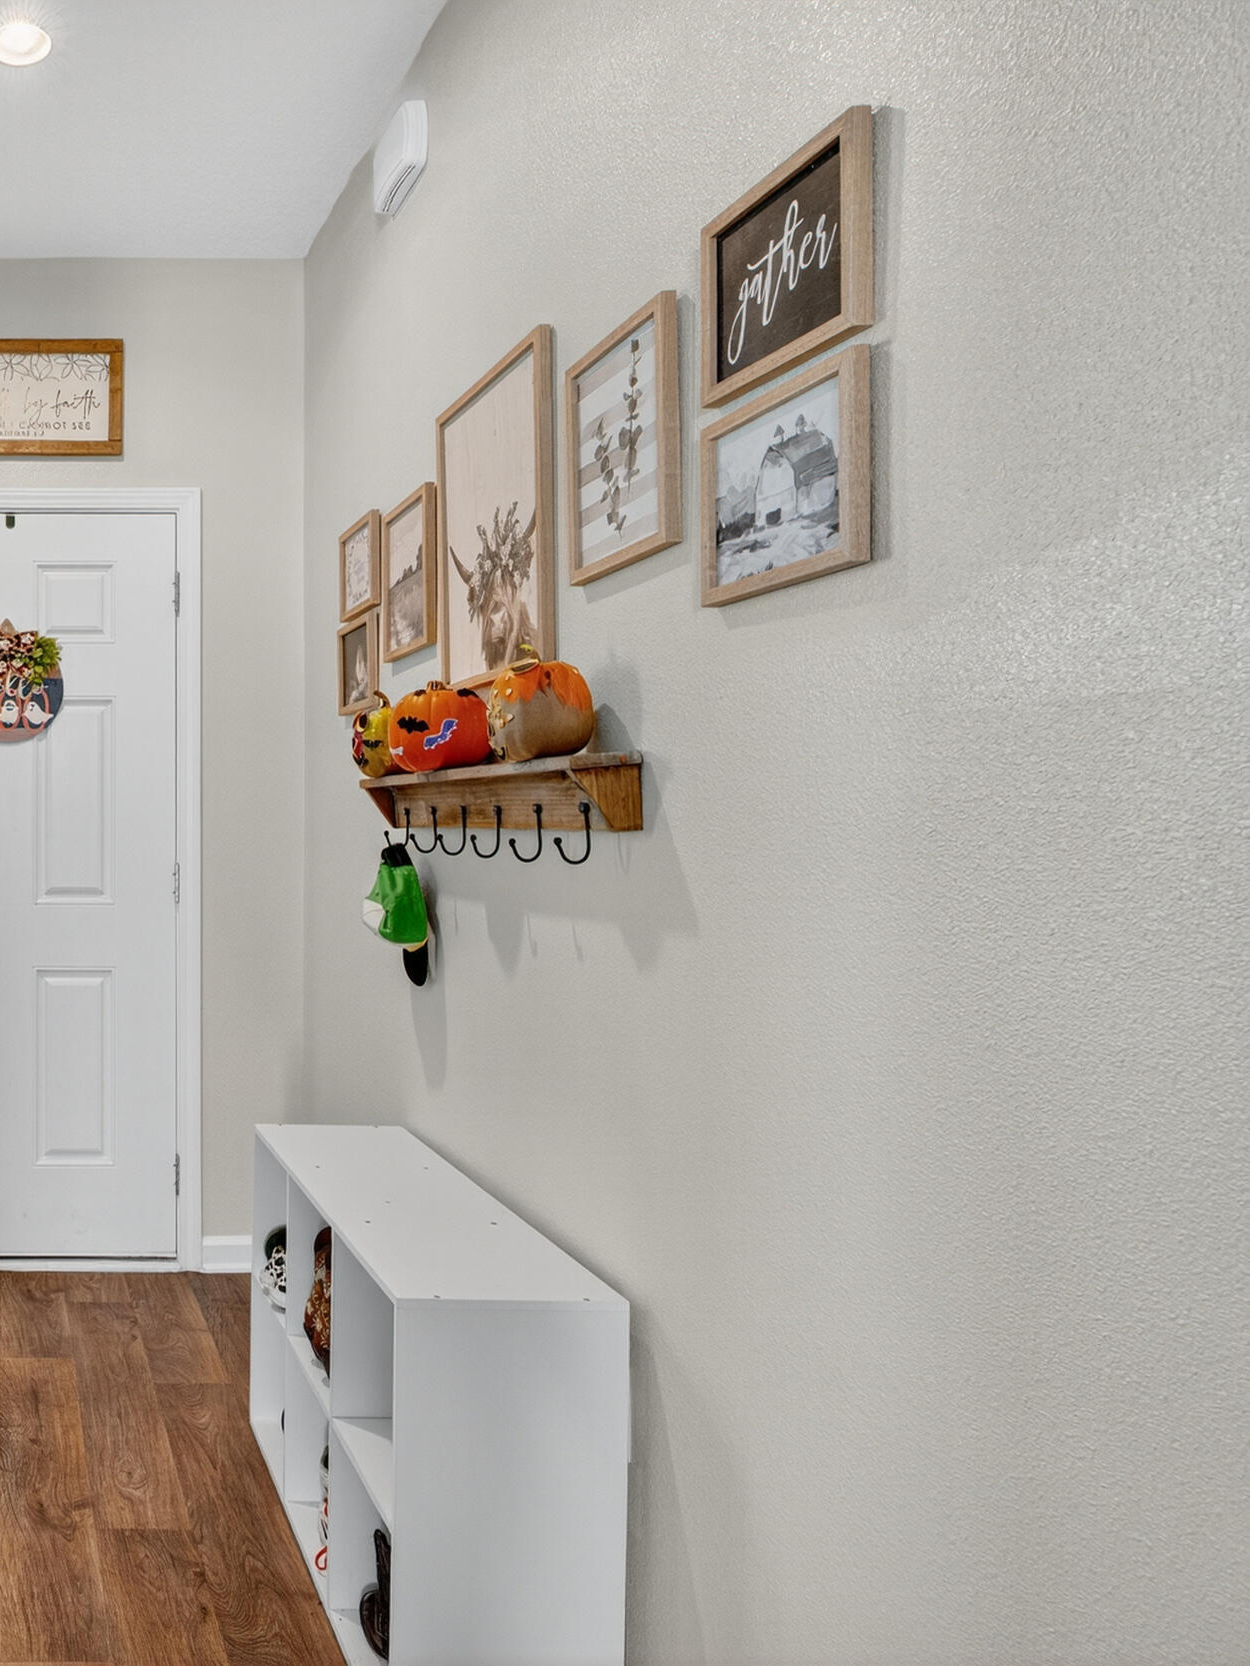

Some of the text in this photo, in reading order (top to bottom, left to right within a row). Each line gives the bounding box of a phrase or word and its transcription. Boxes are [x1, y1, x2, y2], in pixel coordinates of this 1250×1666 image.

[727, 199, 838, 365] gather
[50, 389, 101, 420] faith
[71, 420, 91, 430] SEE
